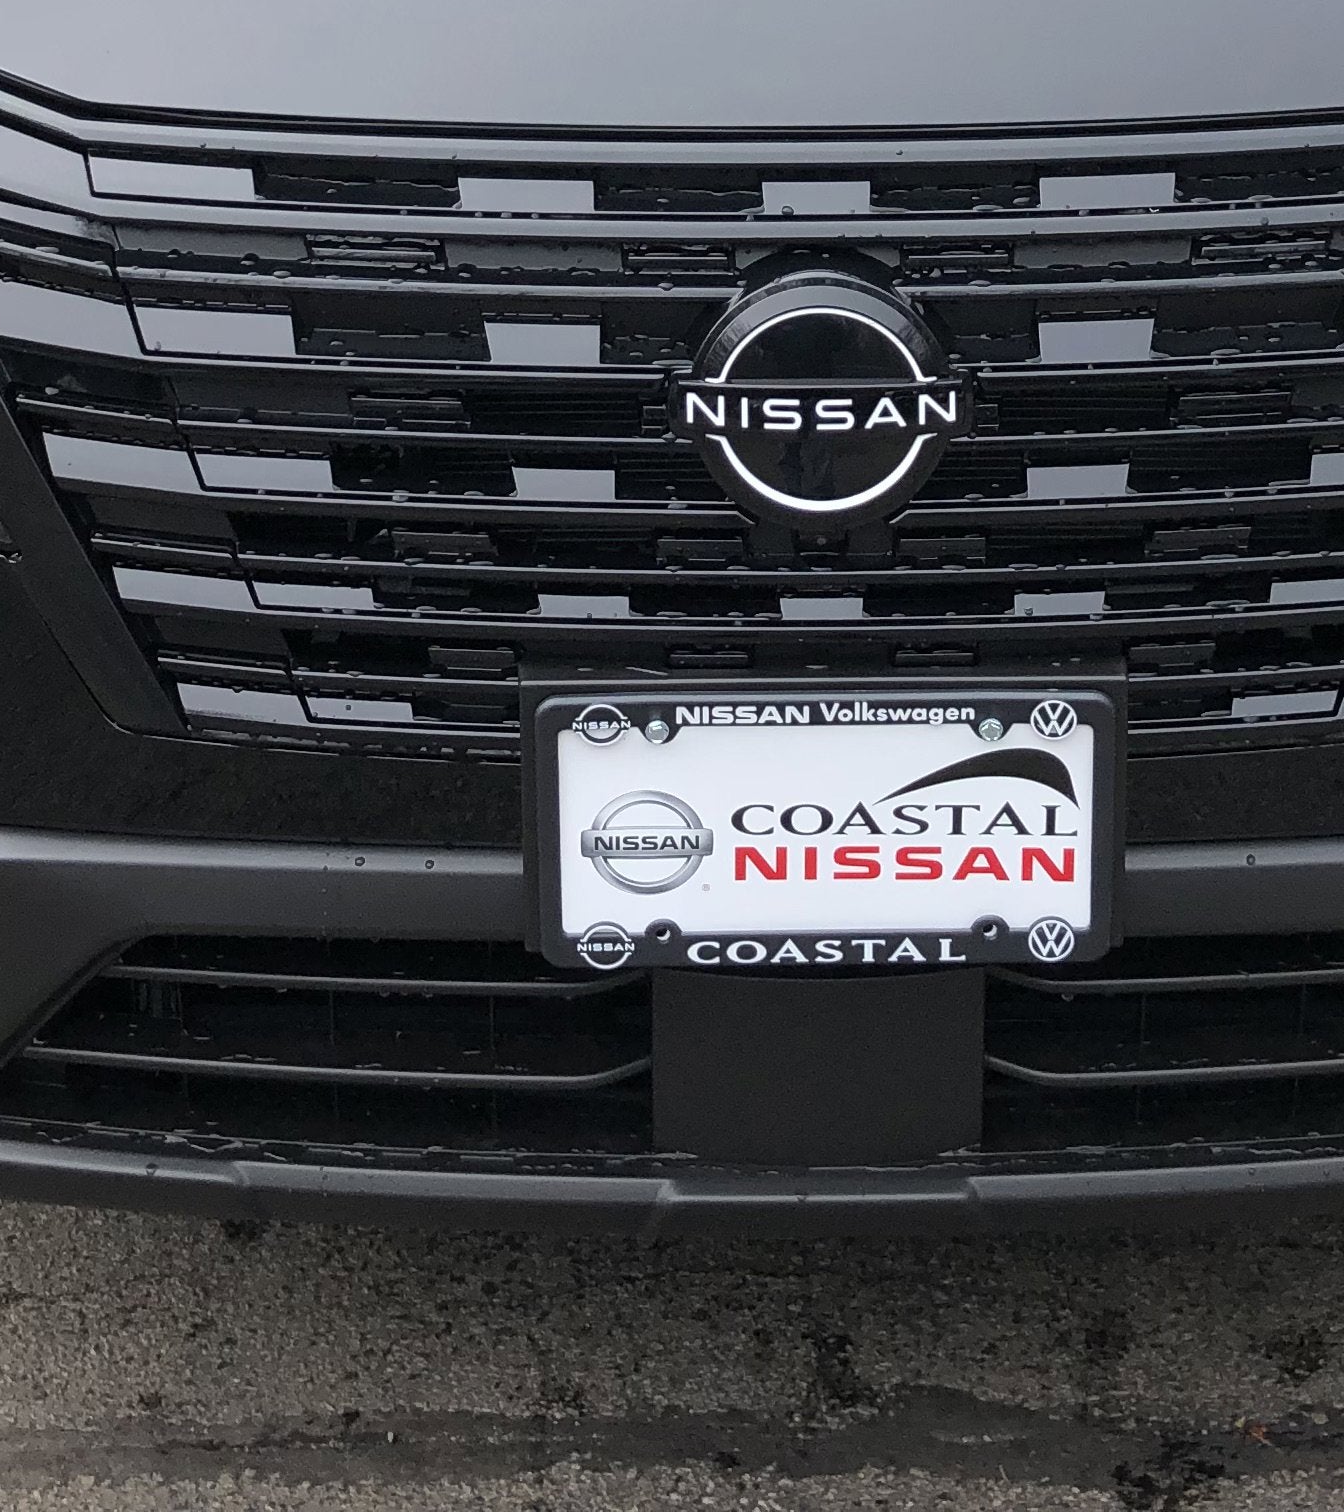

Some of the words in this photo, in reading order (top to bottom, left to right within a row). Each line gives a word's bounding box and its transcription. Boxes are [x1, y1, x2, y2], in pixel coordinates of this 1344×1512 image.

[685, 390, 957, 431] NISSAN
[572, 719, 632, 731] NISSAN
[675, 705, 811, 725] NISSAN
[819, 701, 976, 726] Volkswagen
[729, 800, 1080, 837] COASTAL
[594, 834, 701, 851] NISSAN
[734, 846, 1076, 882] NISSAN
[576, 942, 636, 953] NISSAN
[686, 937, 968, 965] COASTAL
